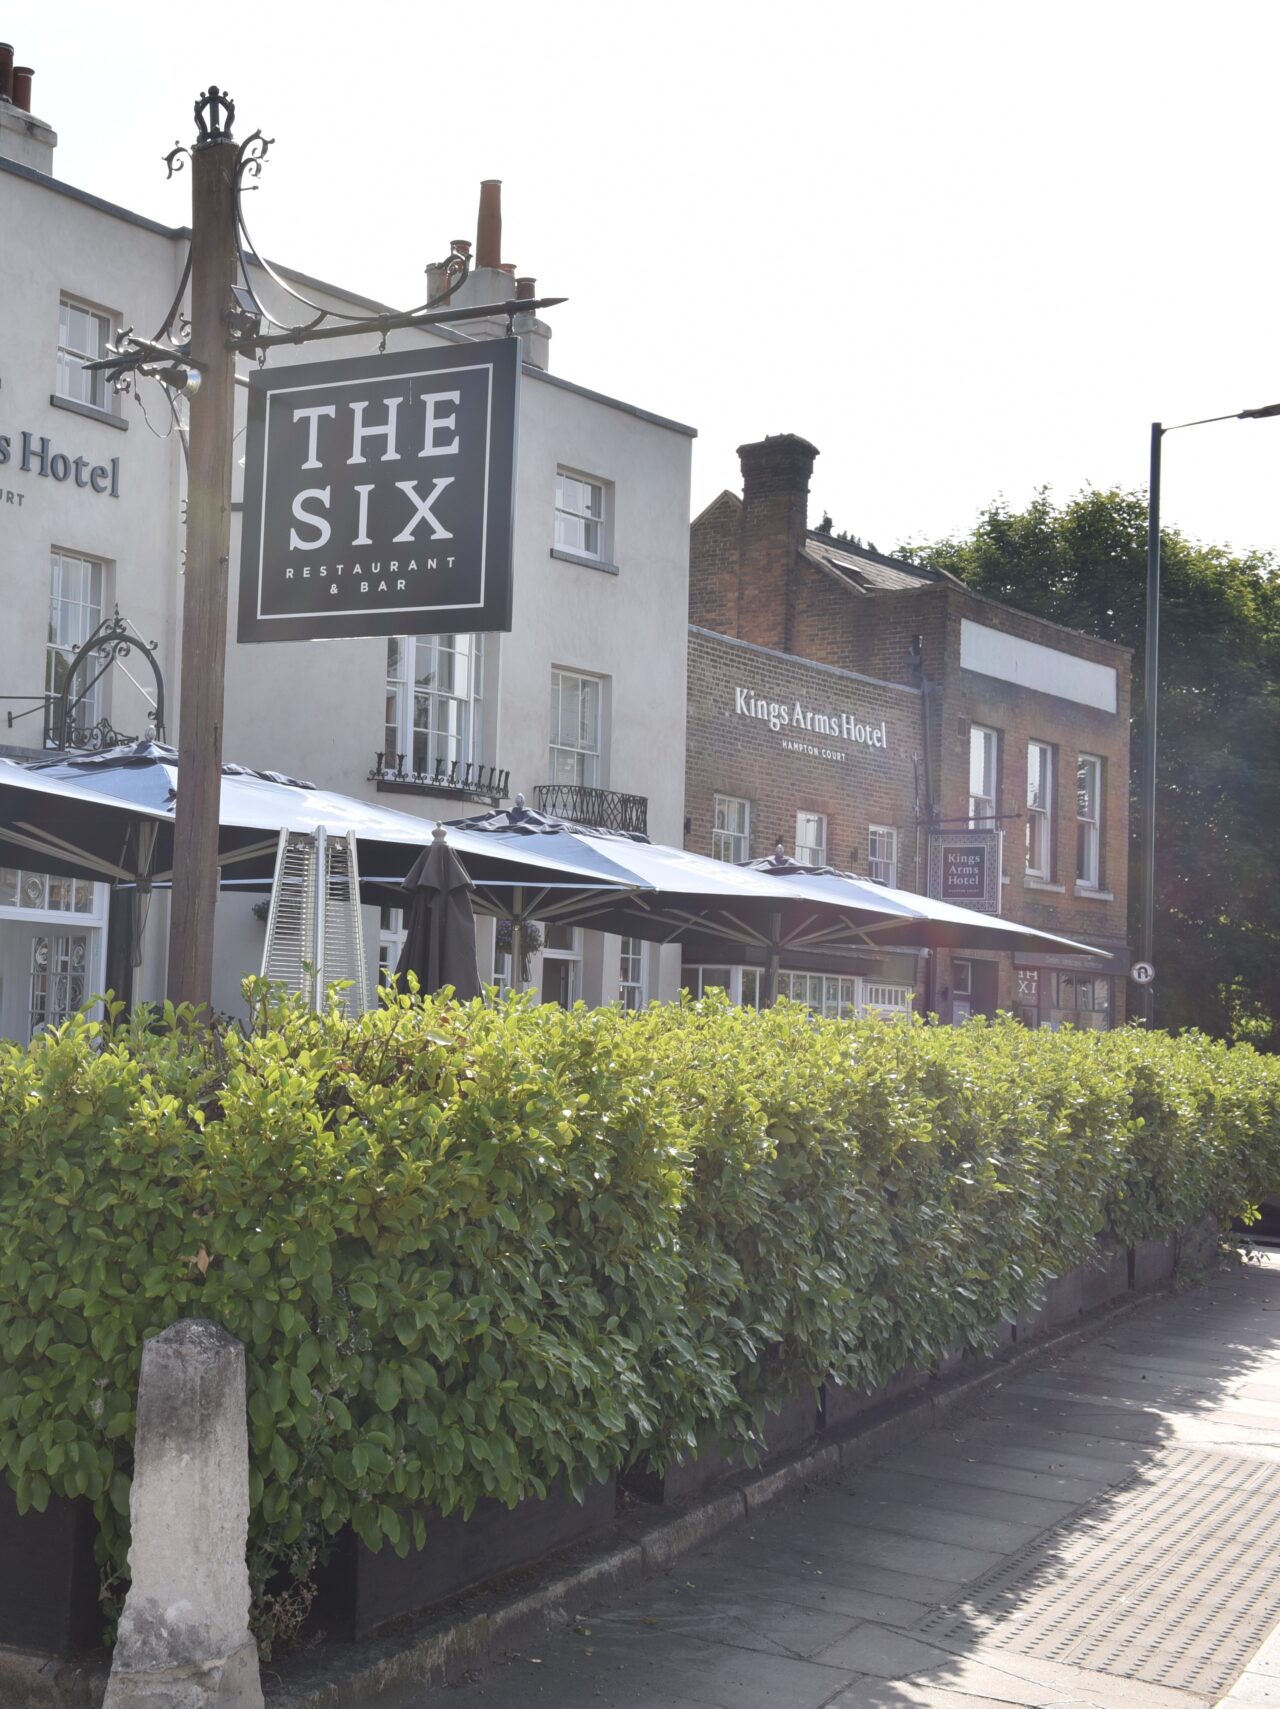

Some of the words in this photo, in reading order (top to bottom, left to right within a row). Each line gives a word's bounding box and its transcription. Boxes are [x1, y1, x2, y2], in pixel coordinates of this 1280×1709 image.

[293, 390, 461, 470] THE
[20, 430, 121, 499] Hotel
[289, 476, 456, 551] SIX
[286, 557, 456, 579] RESTAURANT
[329, 583, 338, 594] &
[360, 579, 406, 593] BAR
[735, 687, 789, 731] Kings
[792, 701, 839, 737] Arms
[841, 713, 887, 749] Hotel
[782, 740, 819, 757] HAMPTON
[821, 748, 846, 762] COURT
[948, 853, 981, 865] Kings
[948, 865, 979, 874] Arms
[948, 875, 979, 885] Hotel
